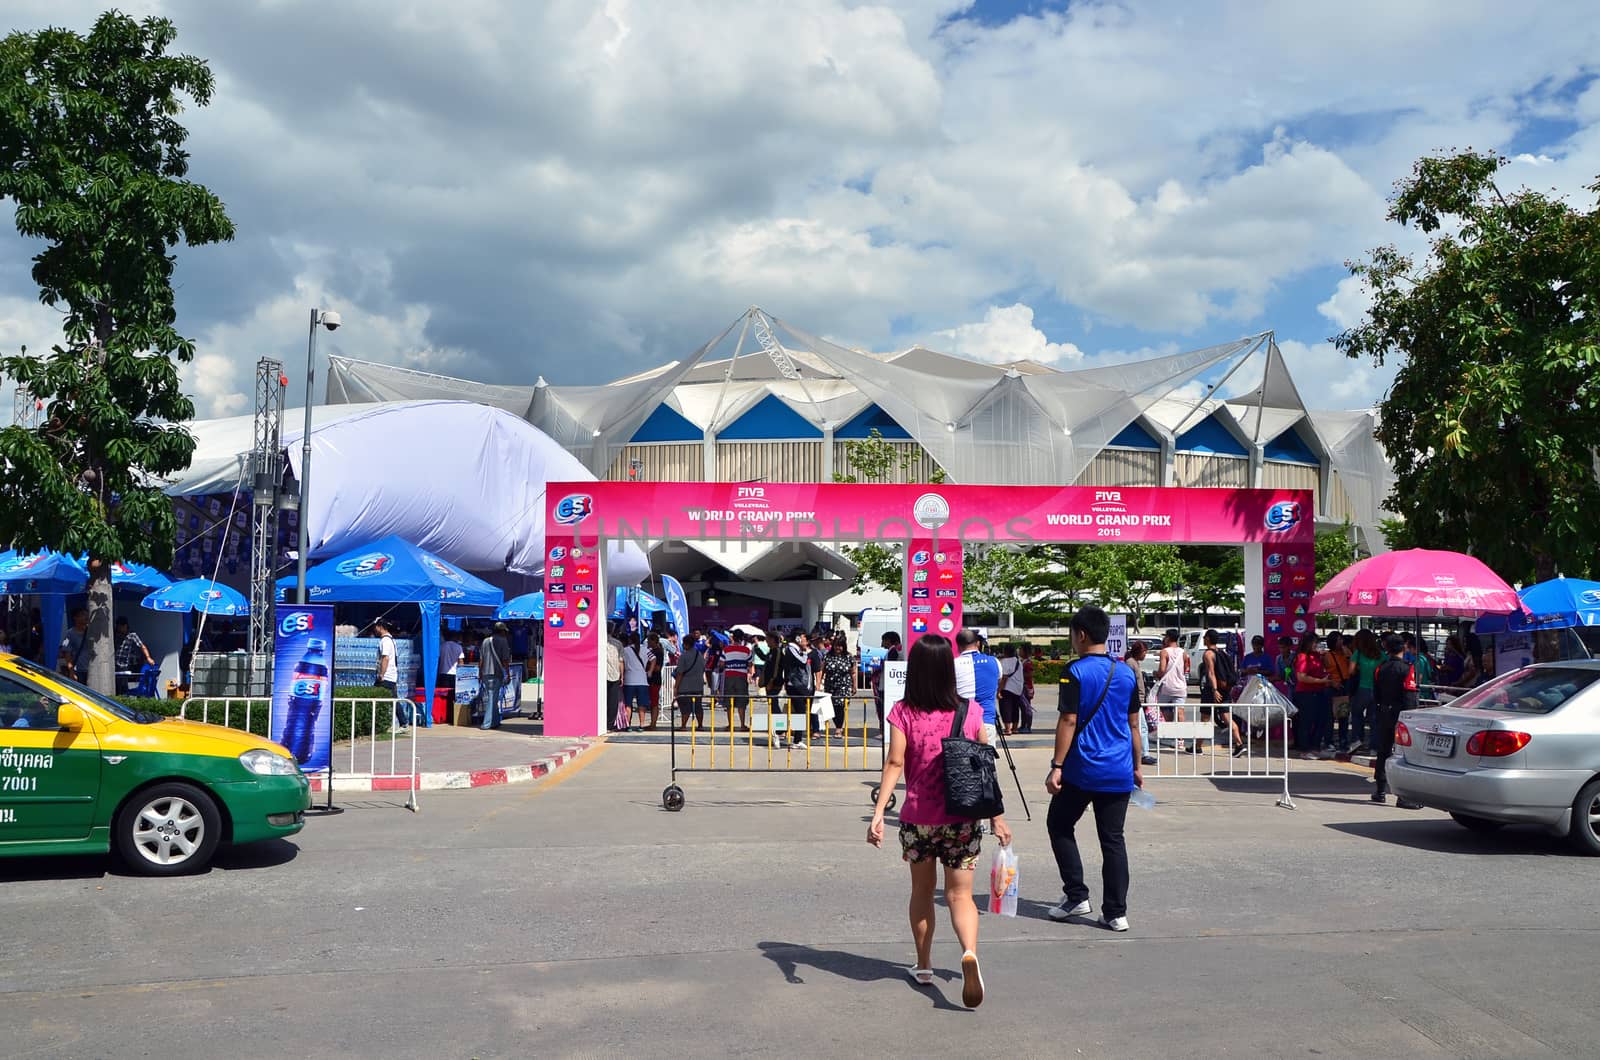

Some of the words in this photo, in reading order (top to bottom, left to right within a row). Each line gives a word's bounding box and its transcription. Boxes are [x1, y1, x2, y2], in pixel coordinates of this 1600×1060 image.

[738, 487, 765, 497] FIVB
[1095, 491, 1121, 501] FIVB
[559, 497, 592, 517] est
[688, 510, 735, 521] WORLD
[738, 510, 783, 521] GRAND
[786, 511, 815, 522] PRIX
[1046, 514, 1093, 525] WORLD
[1095, 514, 1139, 526] GRAND
[1142, 515, 1171, 526] PRIX
[1269, 505, 1300, 525] est
[1097, 528, 1121, 537] 2015
[336, 556, 389, 574] est
[283, 615, 314, 632] est
[1108, 640, 1122, 653] VIP
[889, 668, 907, 679] บัตร
[294, 683, 320, 696] est
[3, 776, 37, 791] 7001
